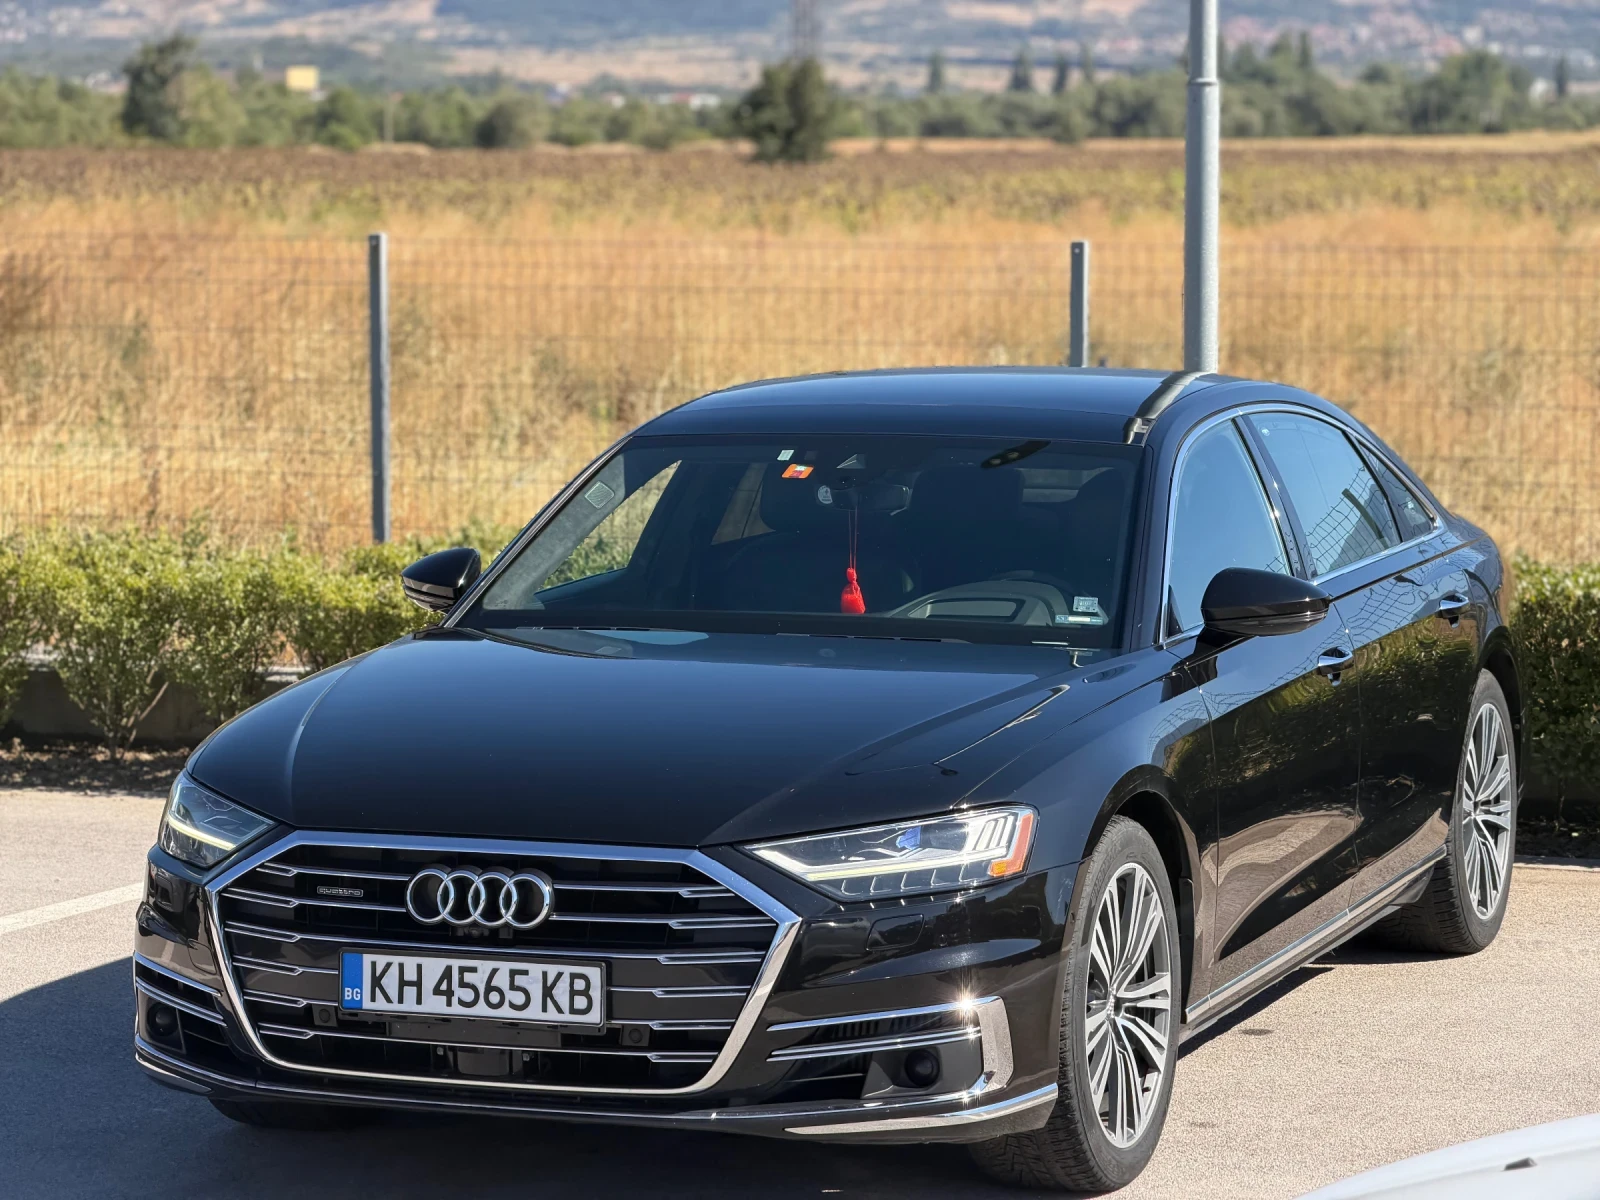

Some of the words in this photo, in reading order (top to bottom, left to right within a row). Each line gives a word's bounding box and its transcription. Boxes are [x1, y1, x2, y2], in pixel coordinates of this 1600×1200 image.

[318, 887, 361, 897] quattro
[344, 987, 361, 1001] BG
[370, 960, 423, 1006] KH
[432, 964, 532, 1012] 4565
[541, 970, 593, 1015] KB
